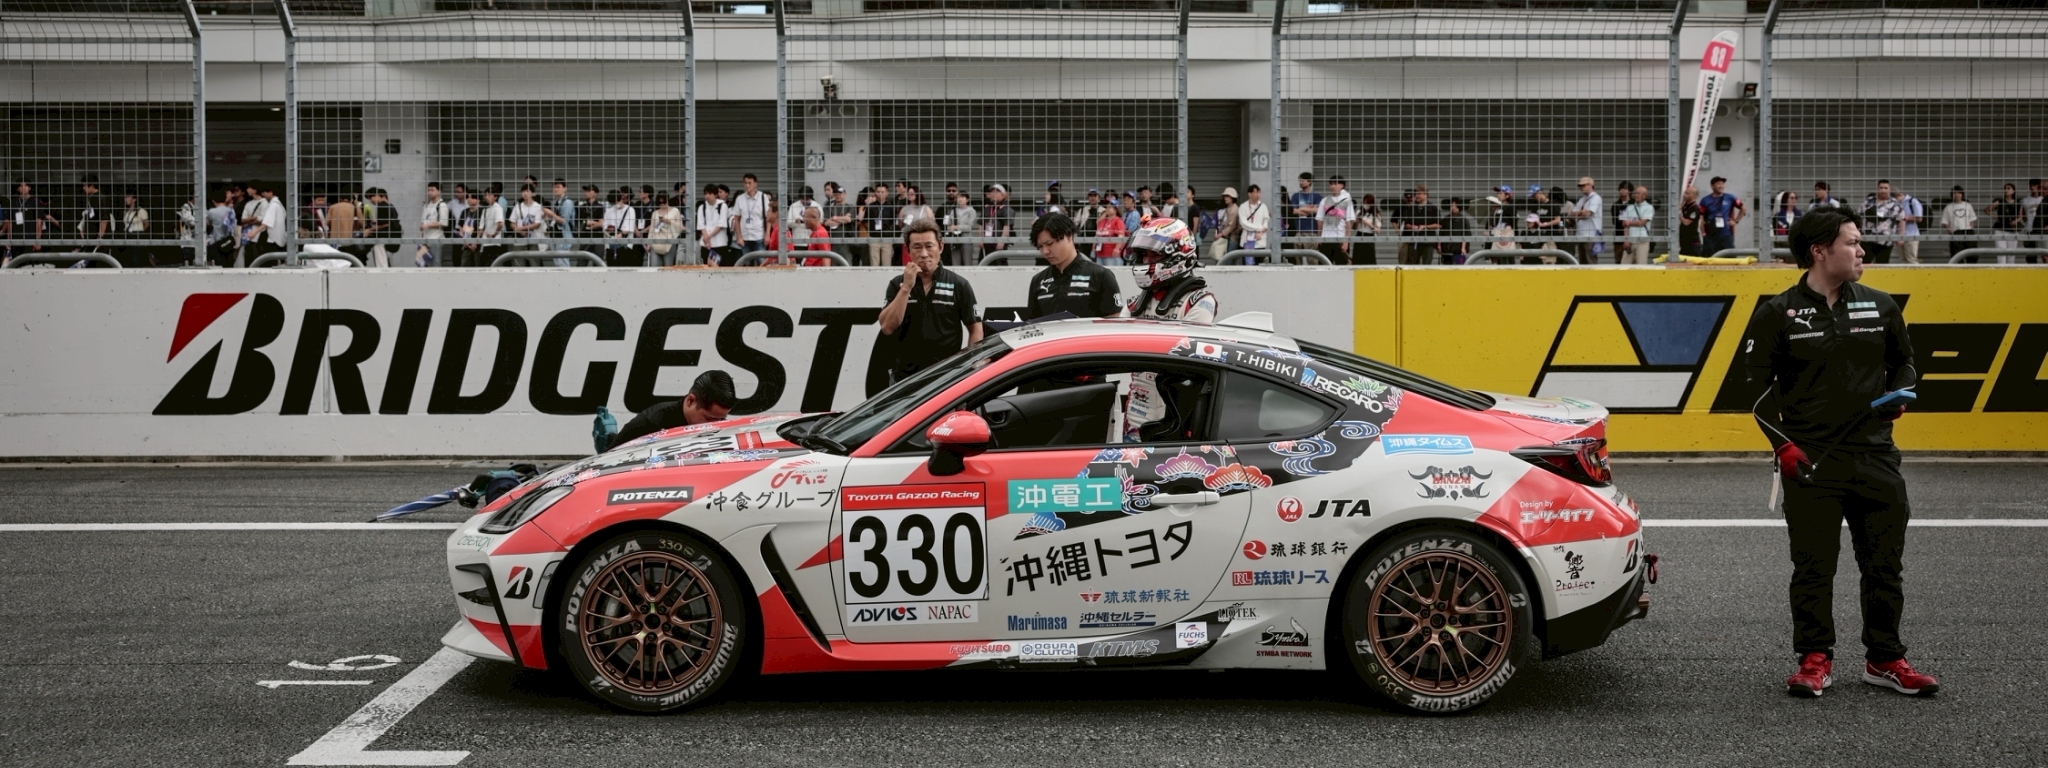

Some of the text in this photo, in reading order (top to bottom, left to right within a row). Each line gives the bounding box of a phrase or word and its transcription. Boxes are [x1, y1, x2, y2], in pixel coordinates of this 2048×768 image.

[365, 157, 380, 170] 21
[807, 156, 824, 169] 20
[1252, 154, 1268, 168] 19
[1797, 306, 1817, 315] JTA
[152, 293, 1030, 415] BRIDGEST
[1235, 350, 1298, 378] T.HIBIKI
[1314, 375, 1384, 414] RECARO
[1388, 437, 1466, 448] 沖縄タイムス
[1432, 475, 1471, 485] BANZAI
[611, 489, 689, 502] POTENZA
[706, 489, 836, 511] 沖食グループ
[848, 490, 980, 501] TOYOTA GAZOO Racing
[1017, 483, 1113, 508] 沖電工
[1308, 499, 1372, 519] JTA
[1520, 500, 1554, 509] Design by
[658, 539, 683, 551] 330
[1270, 541, 1348, 558] 琉球銀行
[849, 512, 985, 599] 330
[1000, 520, 1193, 597] 沖縄トヨタ
[1364, 538, 1474, 590] POTENZA
[1254, 569, 1330, 586] 琉球リース
[565, 539, 642, 633] POTENZA
[1104, 588, 1190, 604] 琉球新報社
[928, 605, 972, 620] NAPAC
[1080, 611, 1156, 623] 沖縄セルラー
[1007, 614, 1068, 631] Marumasa
[1178, 630, 1206, 639] FUCHS
[951, 644, 1011, 654] FUJITSUBO
[1089, 639, 1159, 657] KTMS
